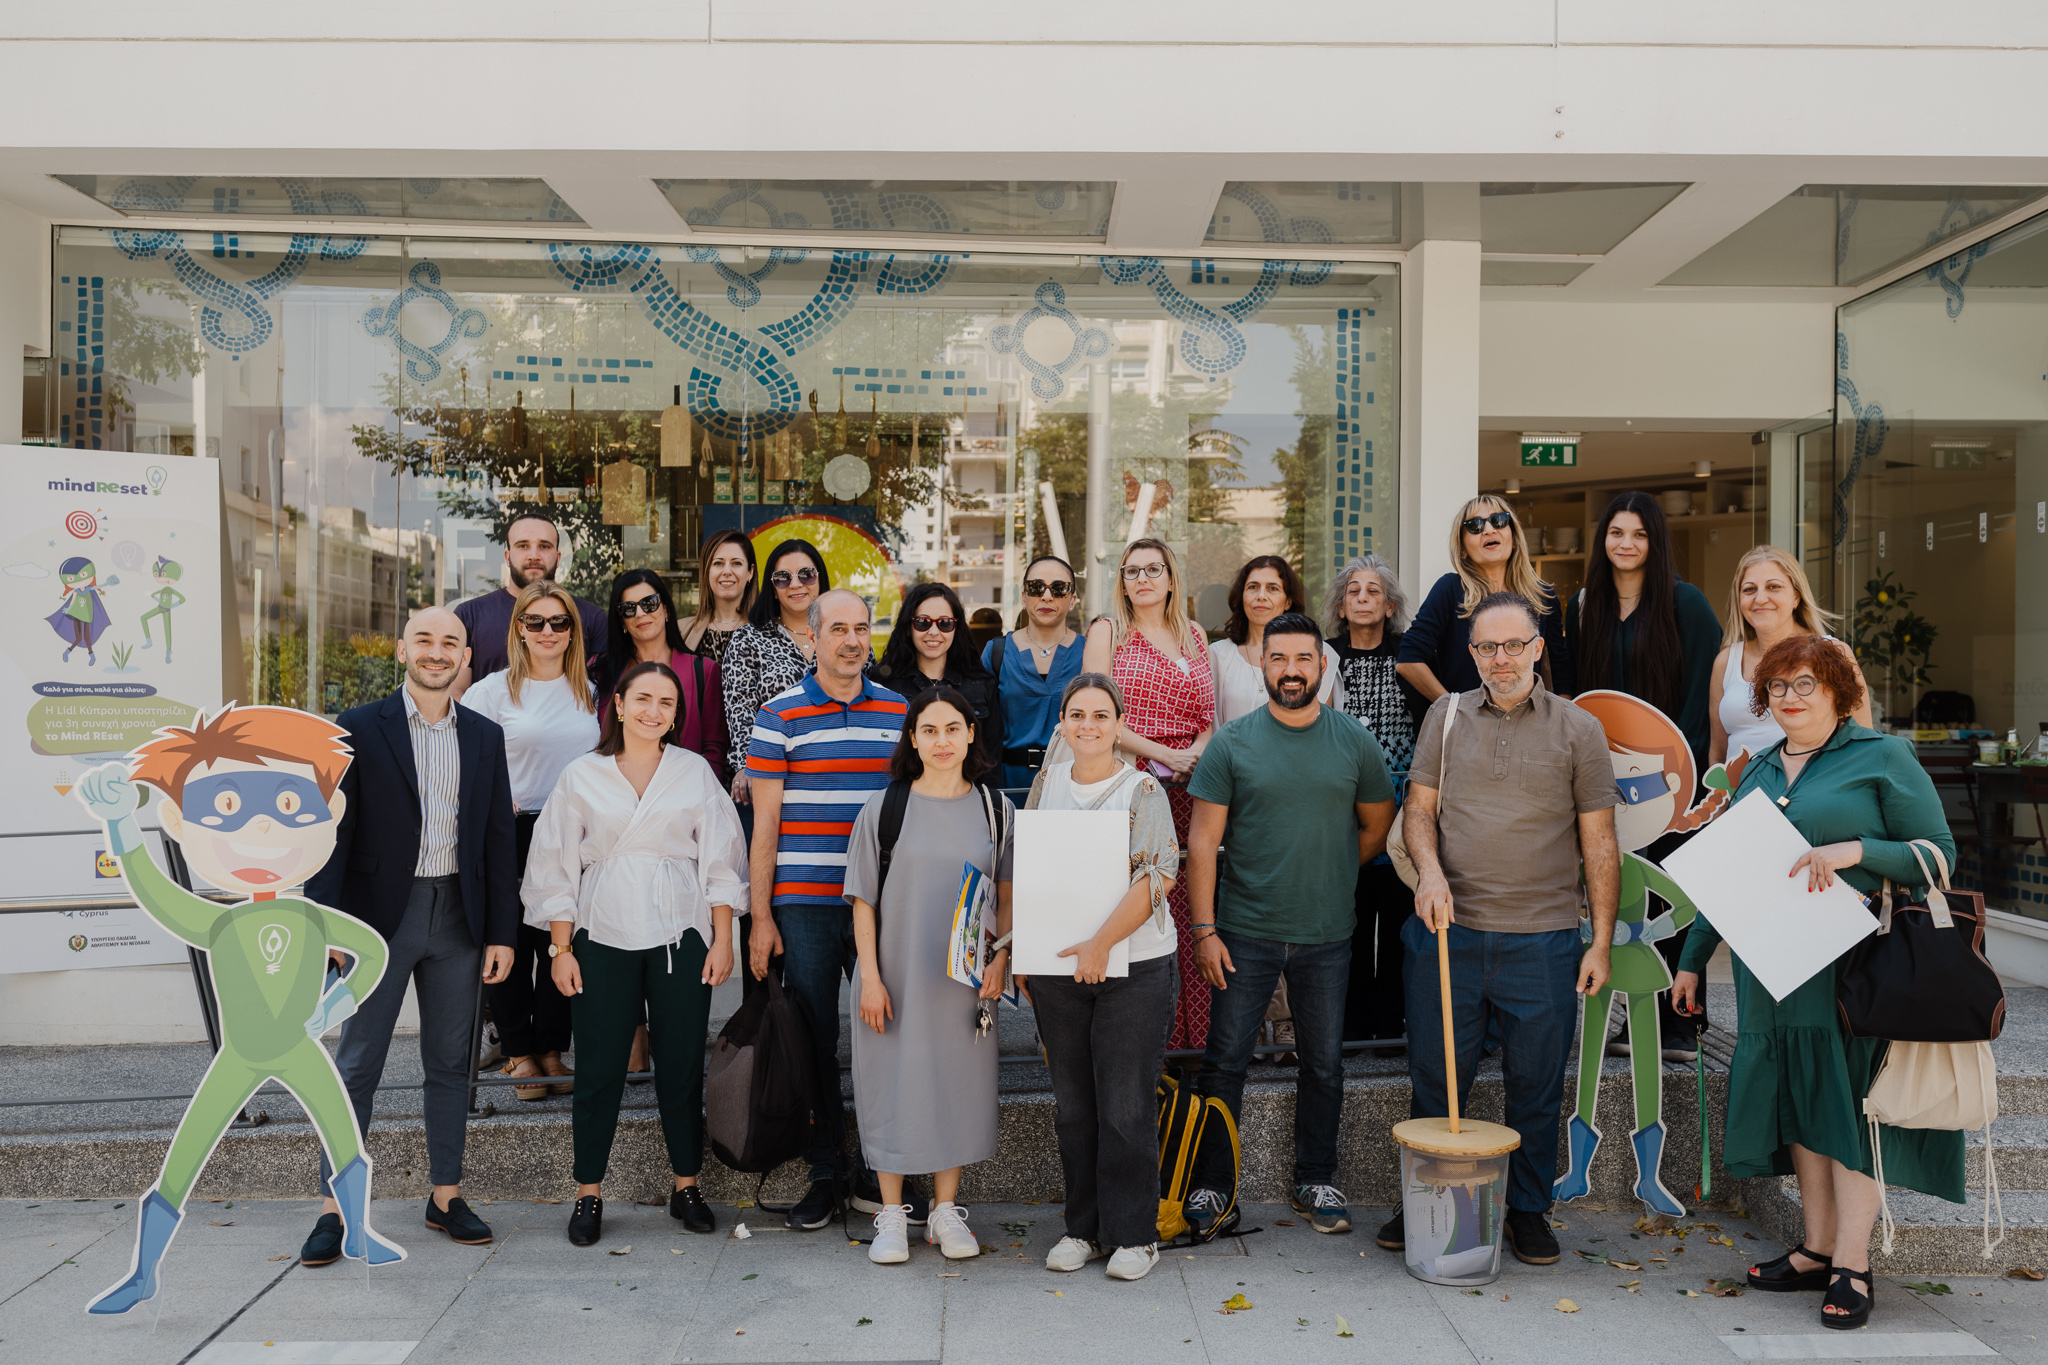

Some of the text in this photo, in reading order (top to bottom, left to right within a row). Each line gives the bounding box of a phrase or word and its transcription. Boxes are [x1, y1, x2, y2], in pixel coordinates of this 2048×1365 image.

[57, 705, 76, 715] Lidl
[80, 705, 121, 717] Κύπρου
[123, 705, 187, 717] υποστηρίζει
[45, 719, 157, 730] για 3η συνεχή χρονιά
[45, 731, 124, 741] το Mind REset
[79, 909, 109, 918] Cyprus
